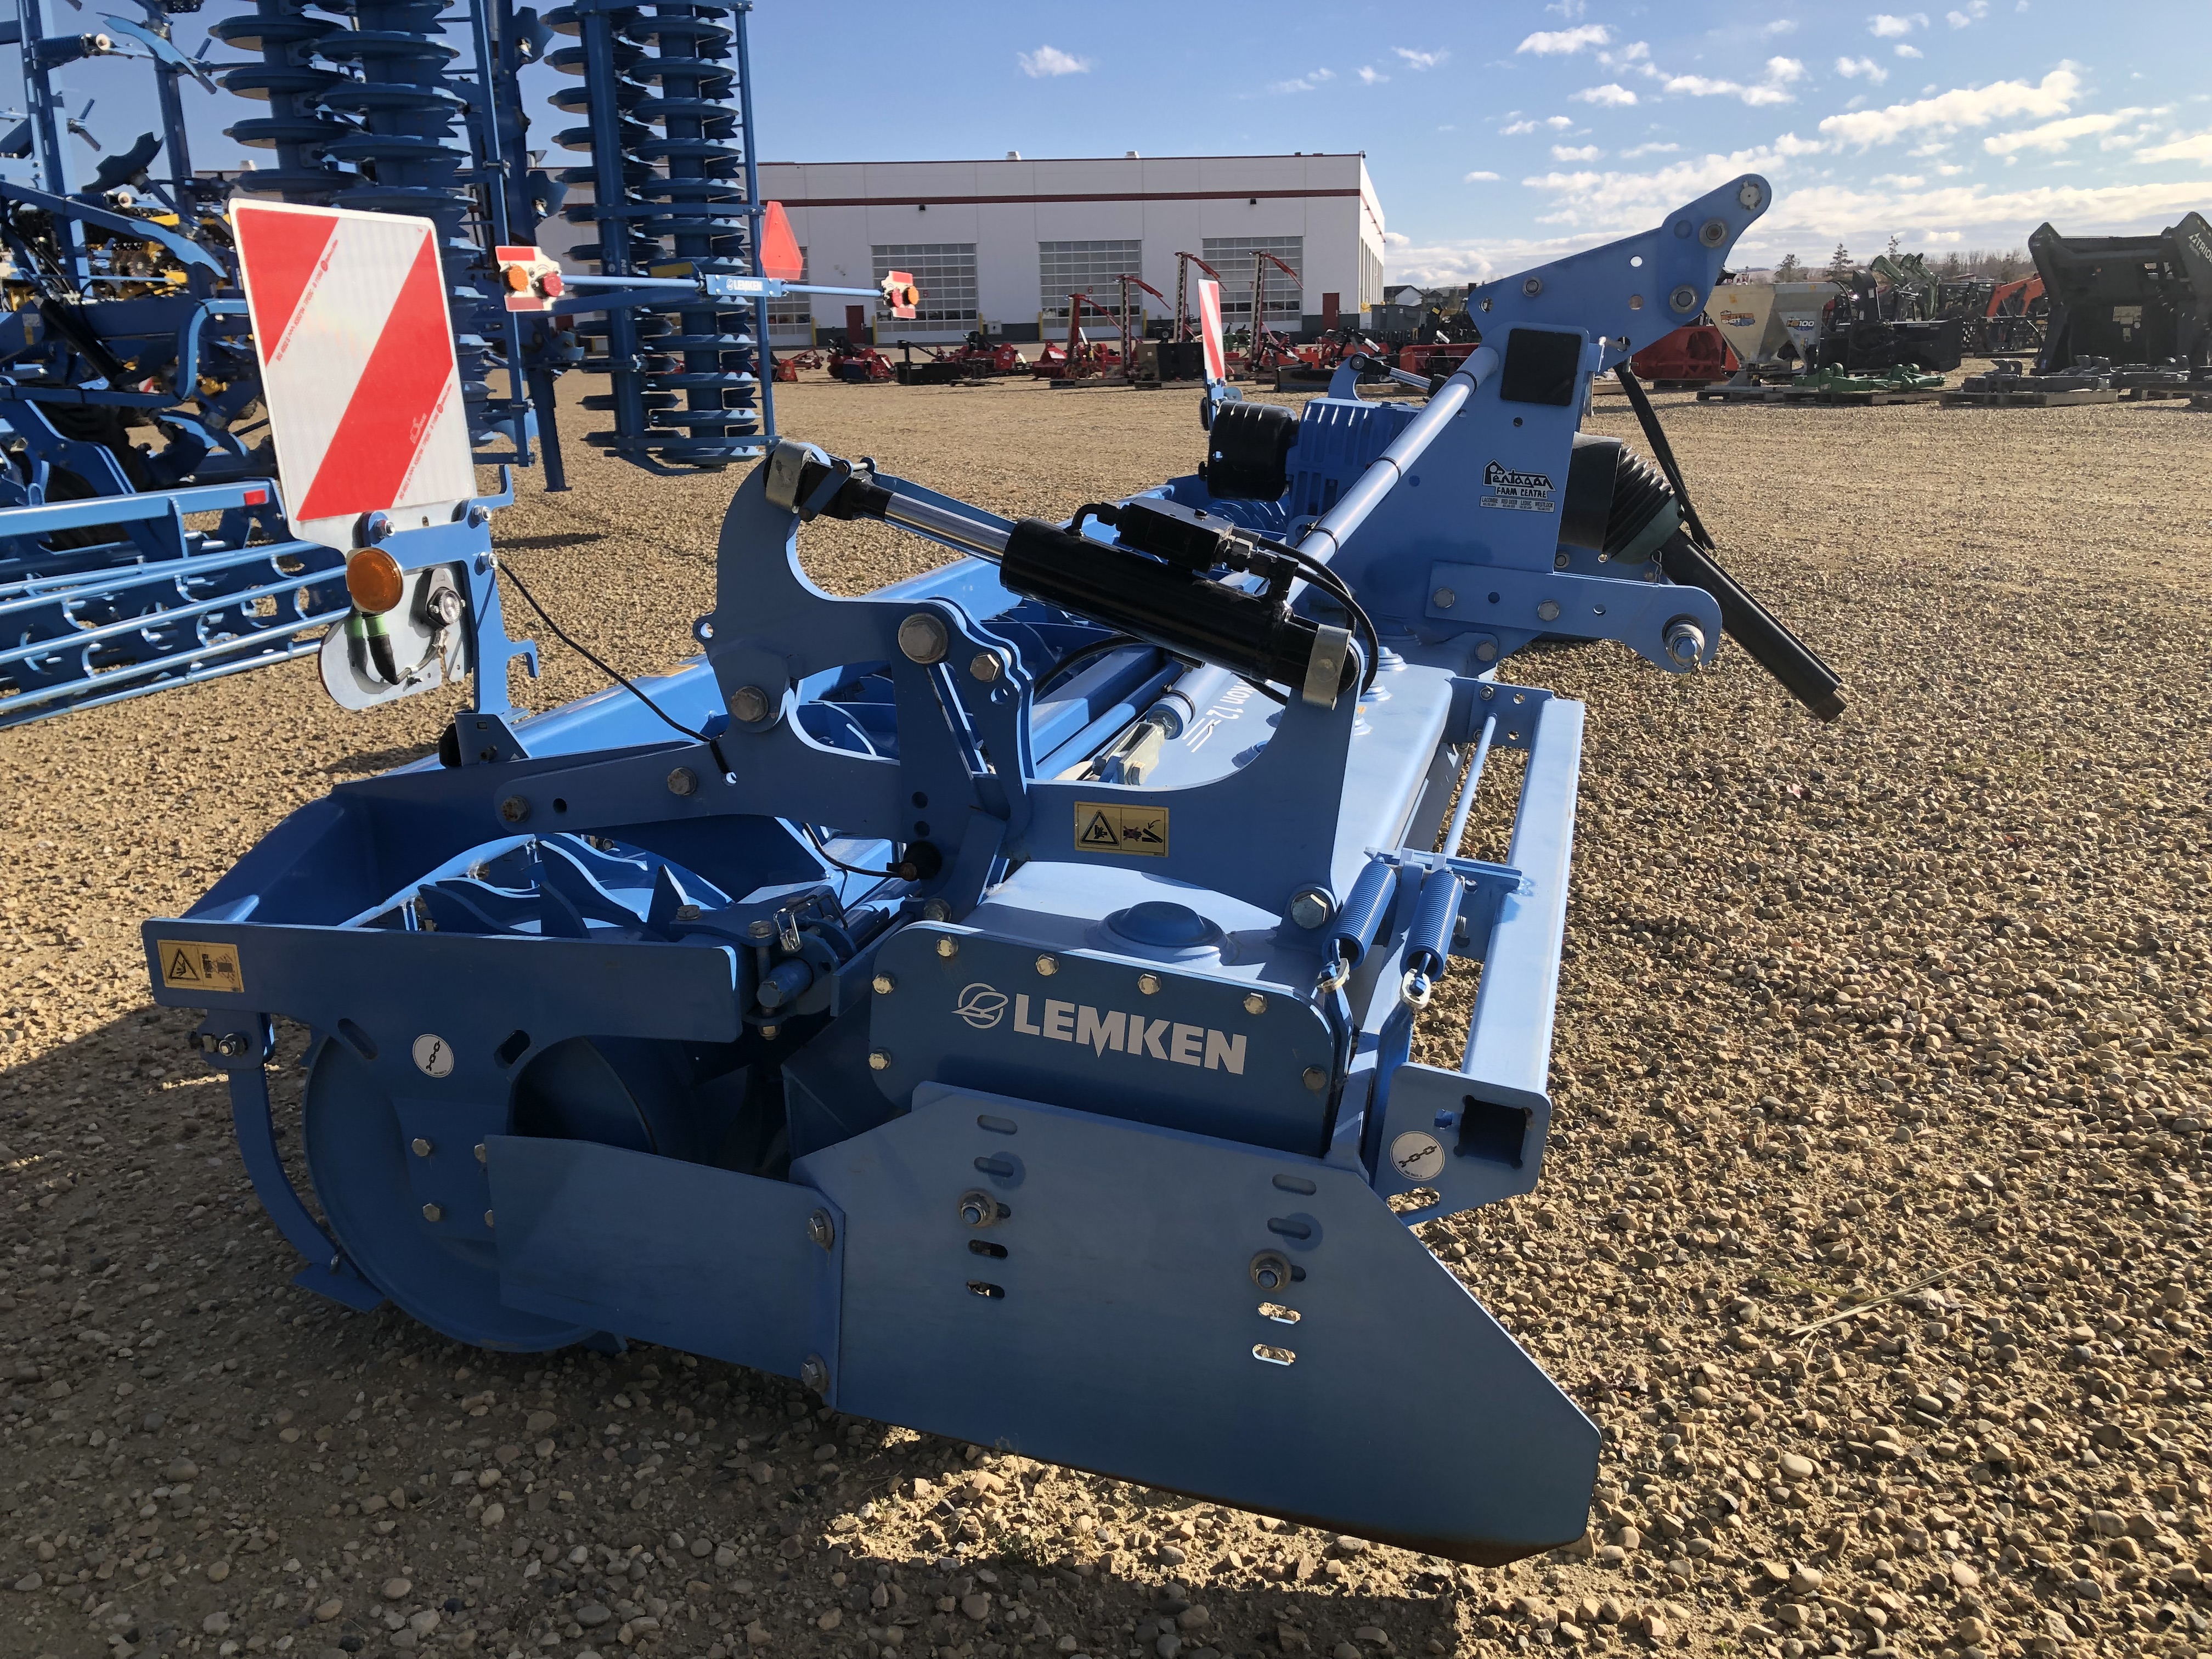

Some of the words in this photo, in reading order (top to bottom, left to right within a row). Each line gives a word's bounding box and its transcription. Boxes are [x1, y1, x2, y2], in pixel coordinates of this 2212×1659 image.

[734, 279, 763, 292] LEMKEN
[1088, 285, 1093, 294] 6
[1249, 281, 1255, 290] 7
[1497, 487, 1517, 496] FARM
[1520, 488, 1547, 498] CENTRE
[1205, 705, 1244, 719] 12
[1013, 993, 1247, 1075] LEMKEN
